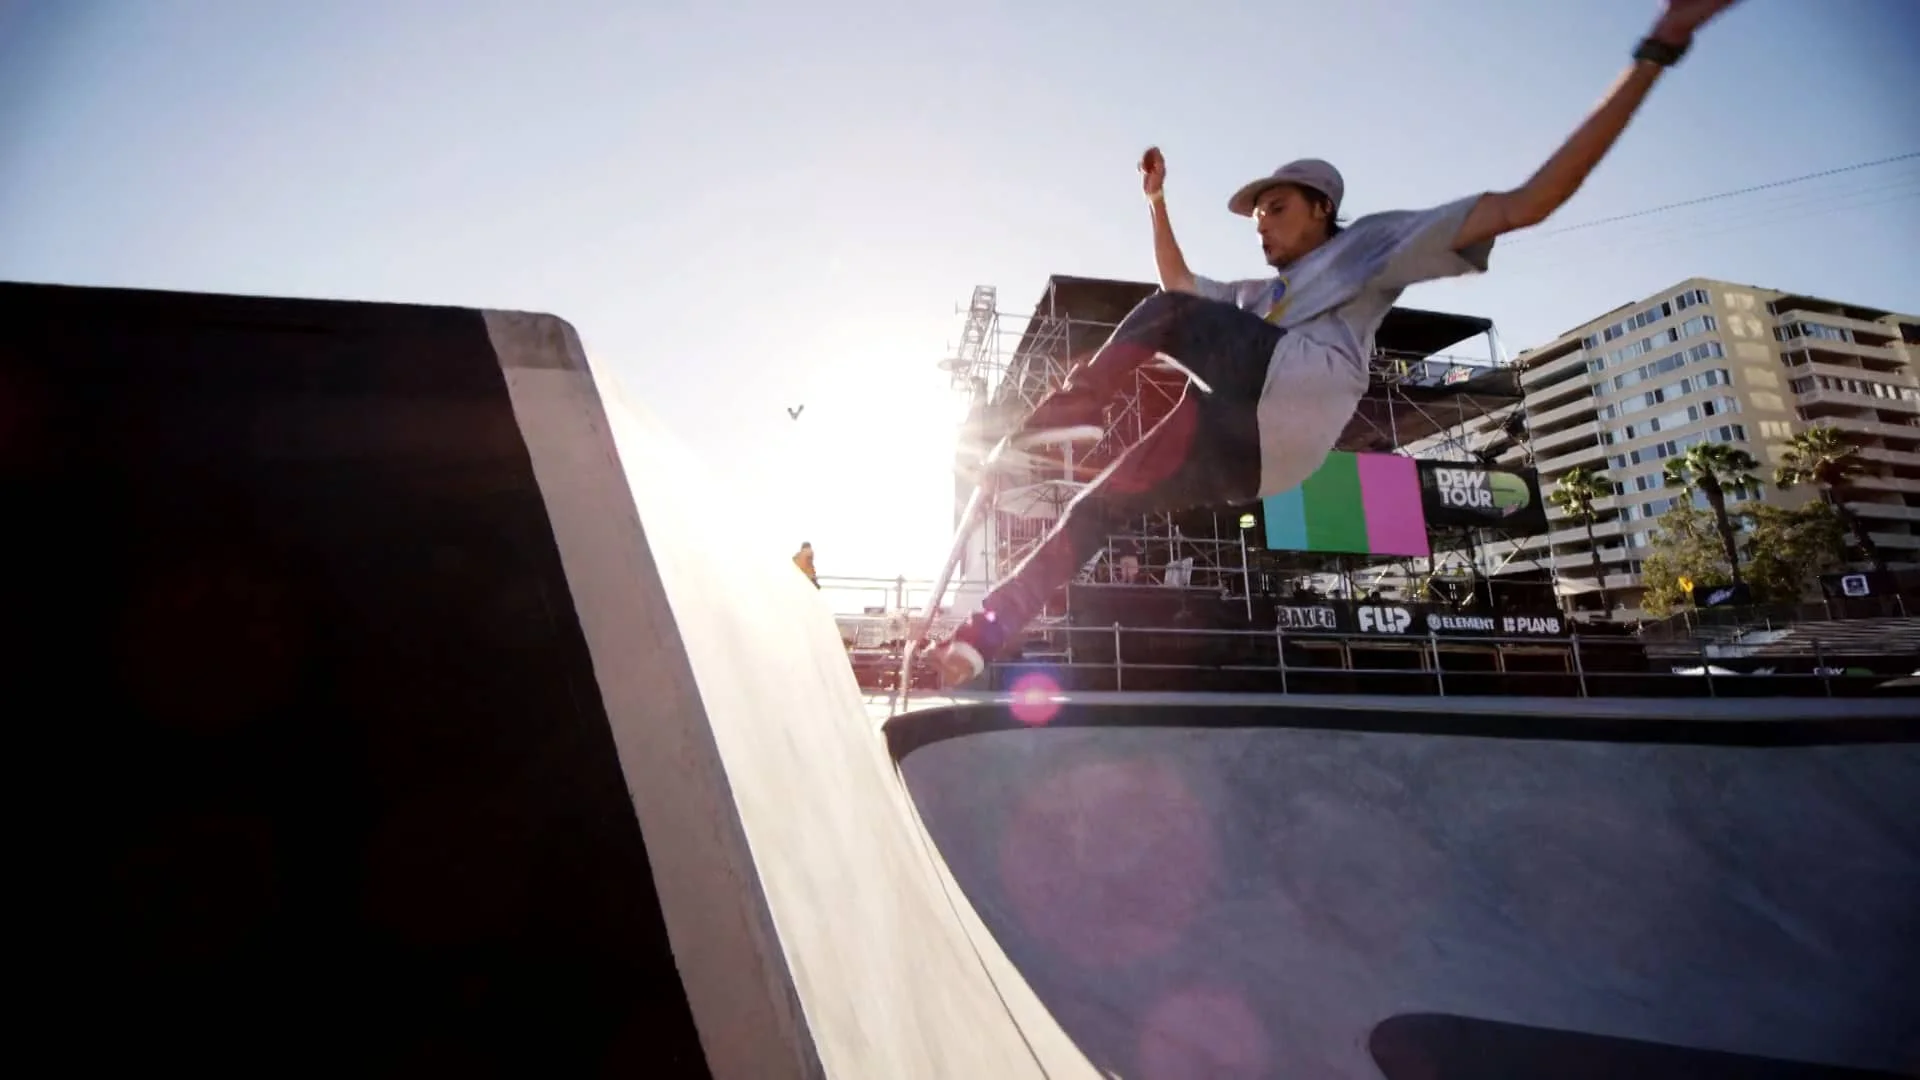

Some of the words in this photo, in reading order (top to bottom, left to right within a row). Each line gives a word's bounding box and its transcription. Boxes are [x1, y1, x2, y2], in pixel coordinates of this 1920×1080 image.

[1435, 467, 1486, 488] DEW
[1440, 487, 1493, 508] TOUR
[1276, 605, 1337, 628] BAKER
[1442, 616, 1495, 630] ELEMENT
